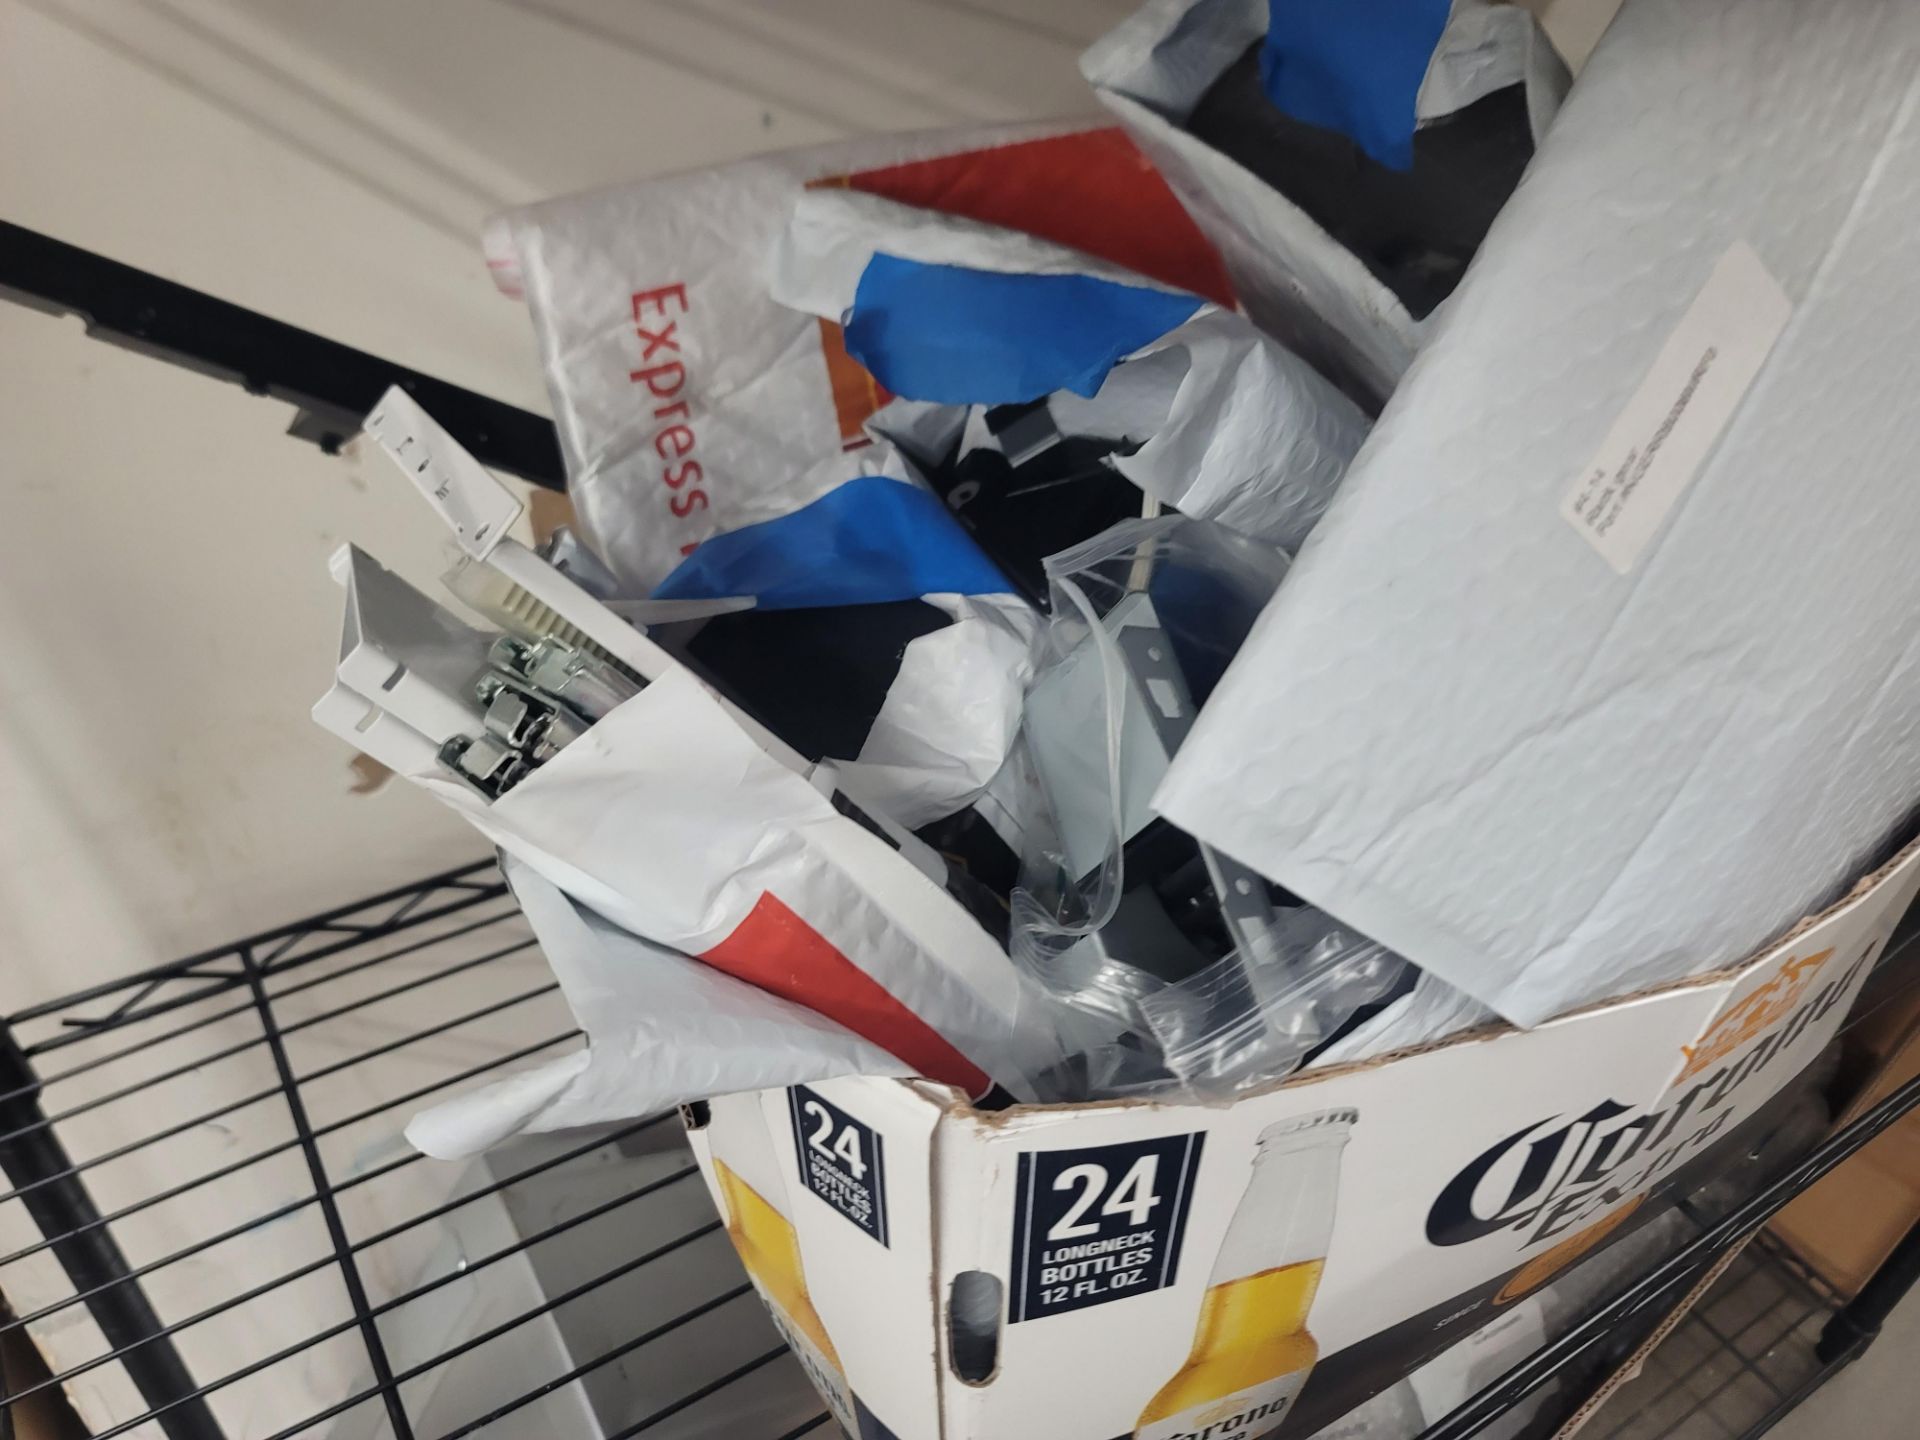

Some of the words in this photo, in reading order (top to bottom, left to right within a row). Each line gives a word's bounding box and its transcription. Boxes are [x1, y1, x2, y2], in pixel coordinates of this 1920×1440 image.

[630, 282, 708, 519] Express
[1425, 938, 1880, 1247] Corona
[804, 1100, 868, 1181] 24
[808, 1149, 871, 1200] LONGNECK
[810, 1162, 873, 1215] BOTTLES
[813, 1177, 829, 1197] 12
[1047, 1153, 1161, 1242] 24
[1517, 1105, 1736, 1252] Extra
[1039, 1247, 1154, 1286] BOTTLES
[1041, 1229, 1157, 1265] LONGNECK
[1039, 1285, 1070, 1305] 12
[1109, 1267, 1149, 1290] OZ.
